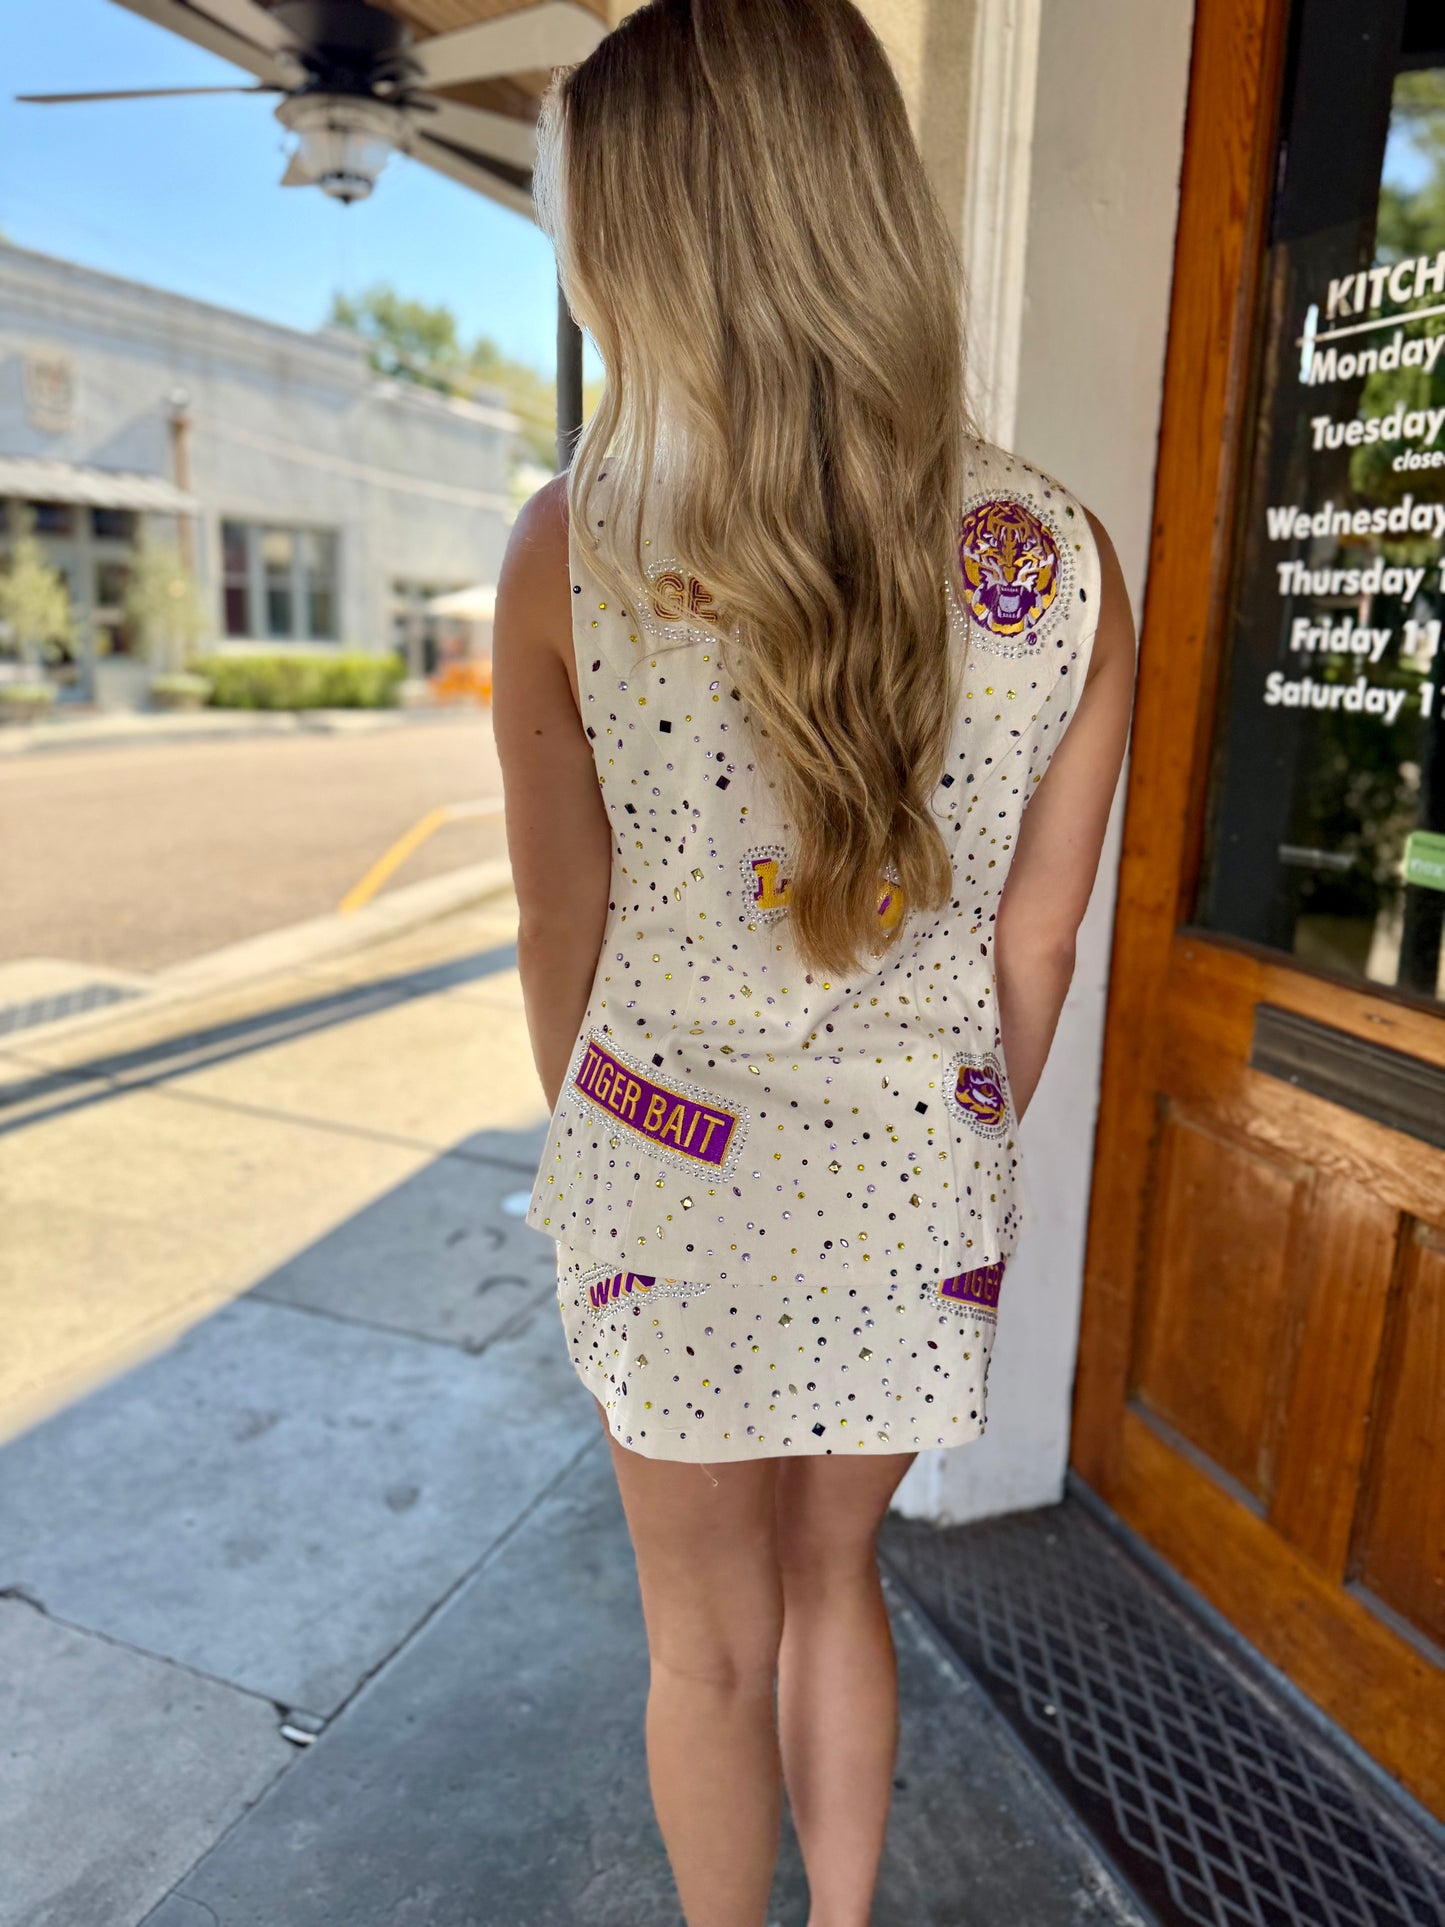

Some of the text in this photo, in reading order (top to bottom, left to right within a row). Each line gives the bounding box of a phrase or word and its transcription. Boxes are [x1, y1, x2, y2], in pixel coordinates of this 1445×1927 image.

[1308, 330, 1445, 386] Monday
[1310, 401, 1445, 451] Tuesday
[1392, 448, 1445, 472] close
[1266, 493, 1445, 540] Wednesday
[1277, 556, 1426, 603] Thursday
[1290, 616, 1392, 662] Friday
[1264, 671, 1406, 726] Saturday
[580, 1047, 725, 1154] TIGER BAIT
